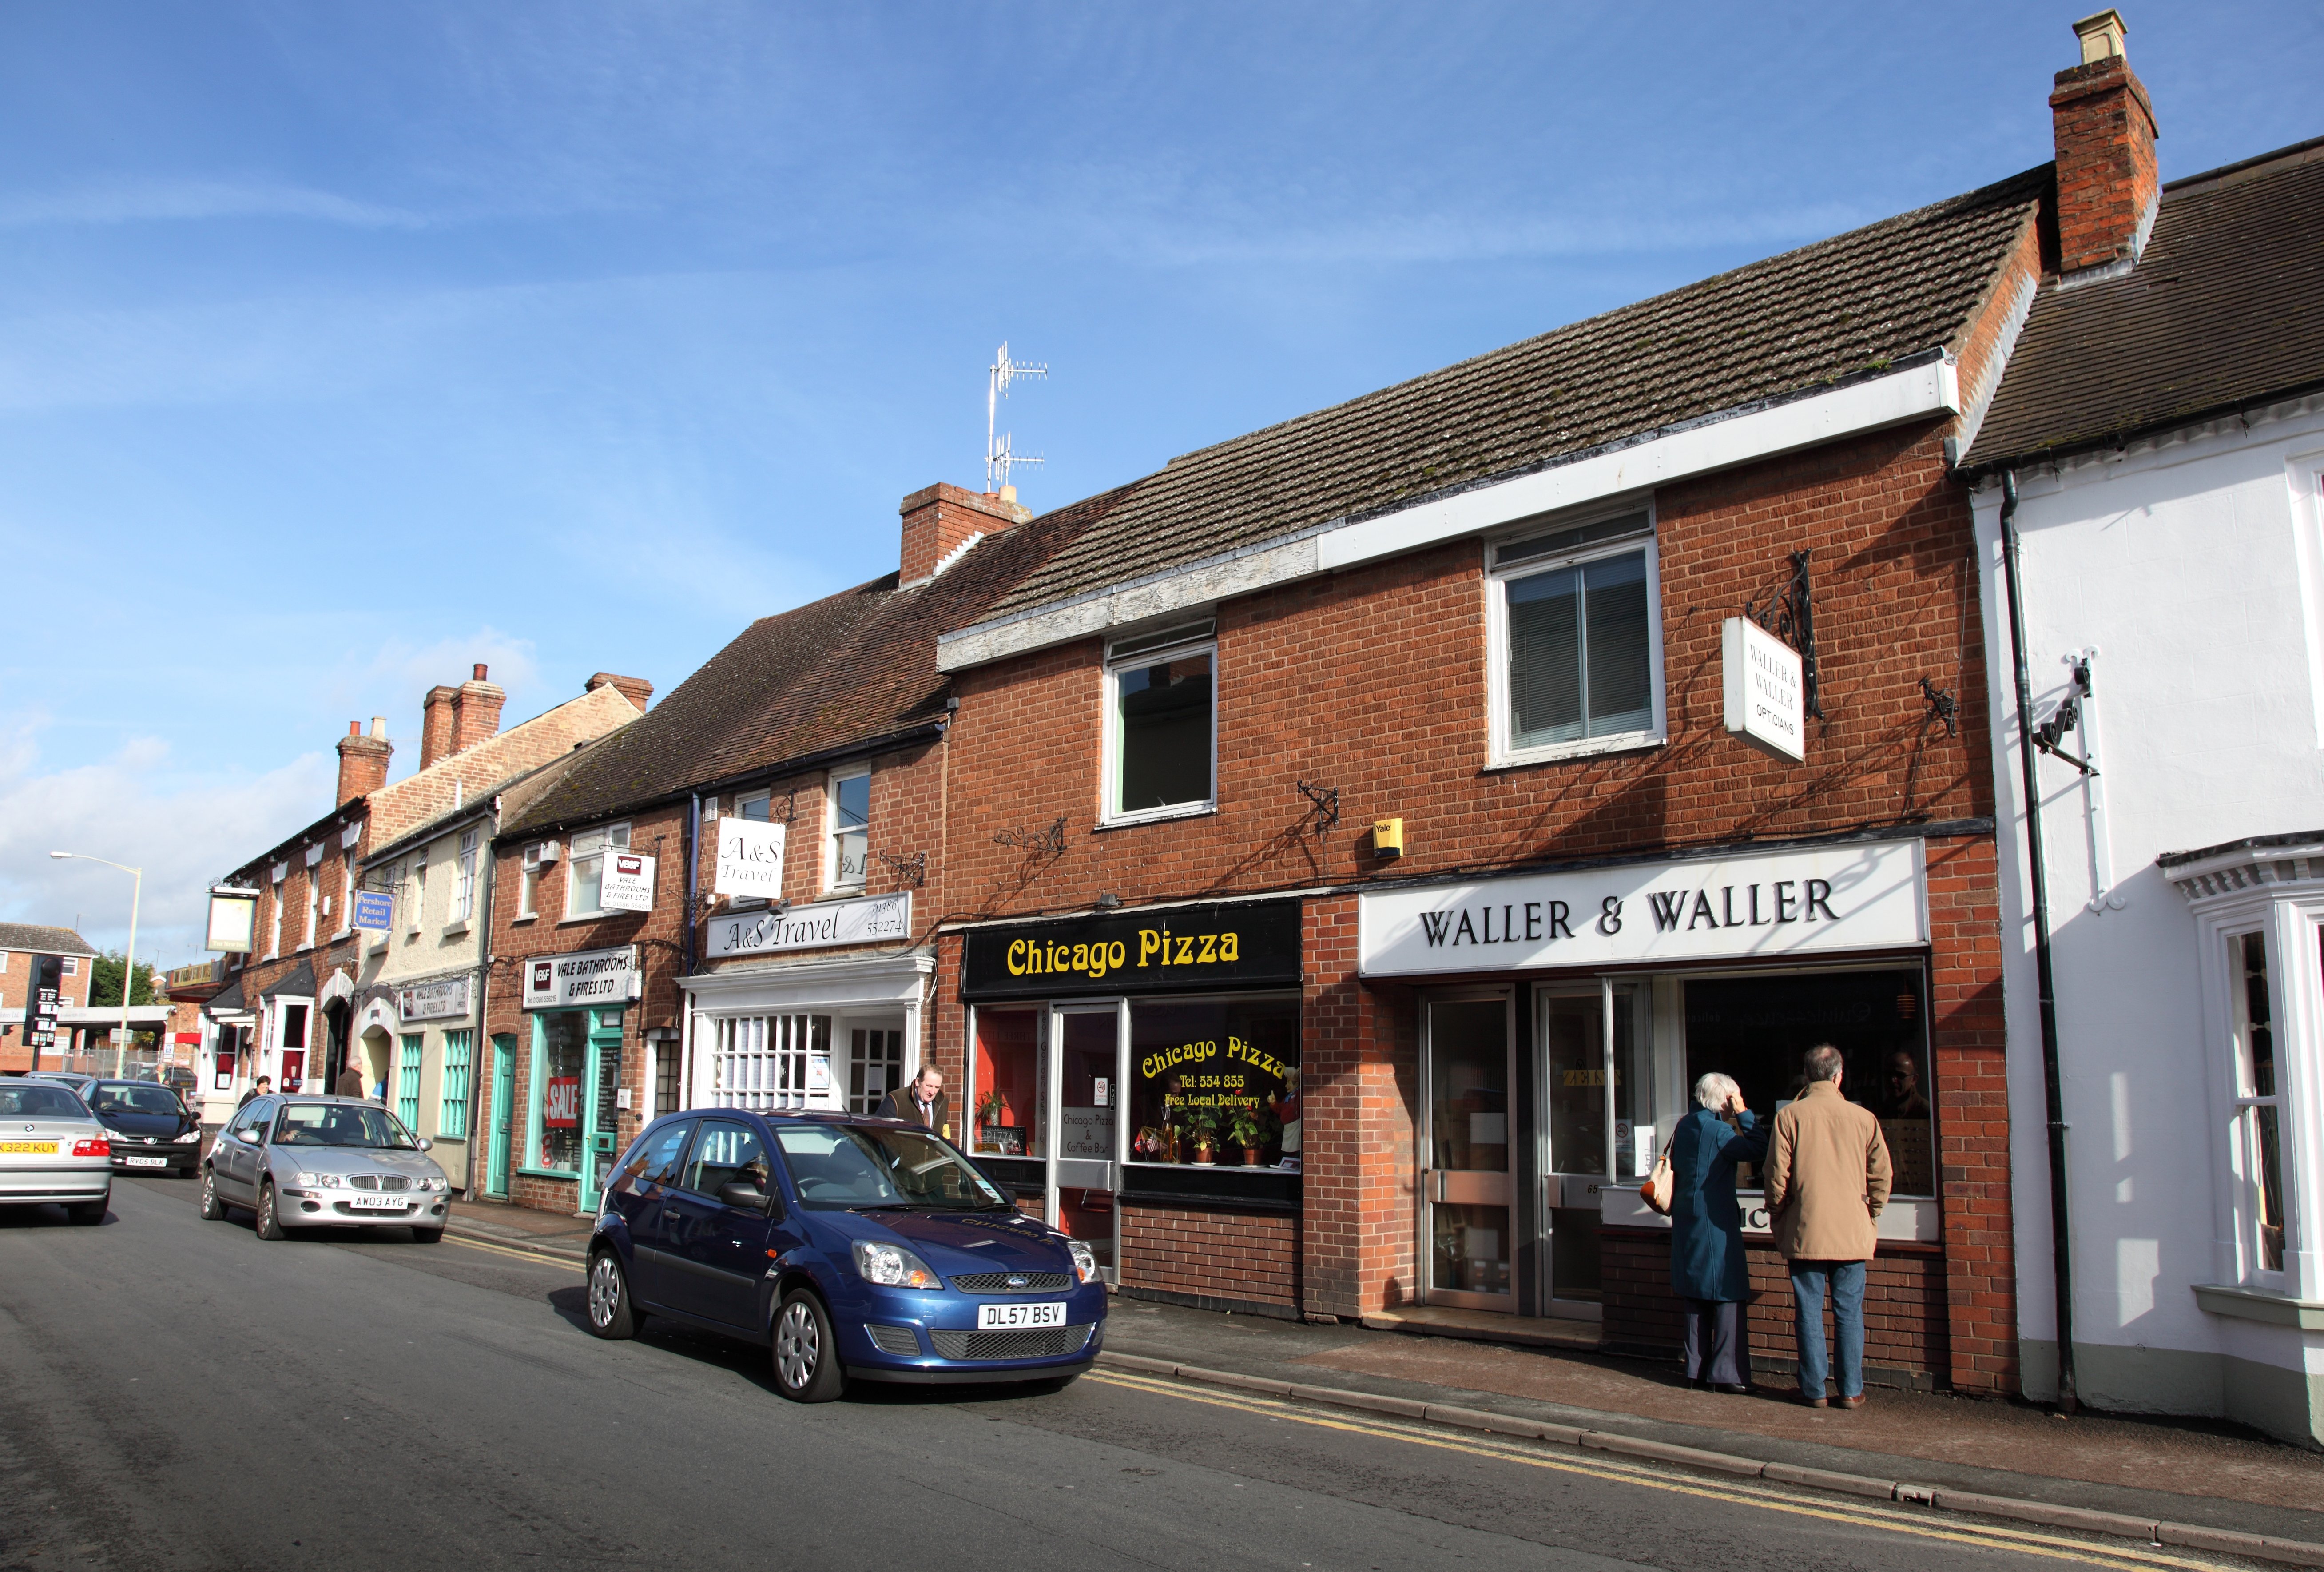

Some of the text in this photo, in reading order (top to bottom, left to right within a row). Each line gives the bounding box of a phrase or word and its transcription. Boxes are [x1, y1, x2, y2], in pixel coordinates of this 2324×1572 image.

[1750, 643, 1796, 688] WALLER &
[1756, 673, 1793, 711] WALLER
[1756, 704, 1794, 736] OPTICIANS
[1376, 824, 1390, 832] Yale
[618, 859, 640, 869] VB&F
[720, 864, 776, 883] Travel
[605, 884, 651, 893] BATHROOMS
[358, 895, 391, 907] Pershore
[872, 899, 898, 914] 01386
[362, 906, 385, 916] Retail
[1420, 878, 1840, 947] WALLER & WALLER
[359, 915, 387, 926] Market
[771, 905, 846, 946] Travel
[866, 919, 902, 936] 552274
[1007, 929, 1239, 978] Chicago Pizza
[557, 956, 628, 978] VALE BATHROOMS
[534, 968, 550, 982] VB&F
[427, 983, 453, 999] BATHROOMS
[569, 983, 575, 997] &
[576, 980, 599, 998] FIRES
[600, 979, 614, 993] LTD
[426, 1001, 438, 1015] FIRES
[1142, 1036, 1285, 1079] Chicago Pizza
[1180, 1075, 1244, 1088] Tel: 554 855
[549, 1084, 577, 1119] SALE
[1164, 1094, 1260, 1109] Free Local Delivery
[1064, 1114, 1113, 1128] Chicago Pizza
[987, 1131, 1013, 1144] PIZZA
[1085, 1130, 1091, 1140] &
[33, 1143, 57, 1153] KUY
[1067, 1142, 1109, 1154] Coffee Bar
[1588, 1185, 1598, 1194] 65
[356, 1197, 404, 1206] AW03 AYG
[987, 1305, 1060, 1325] DL57 BSV
